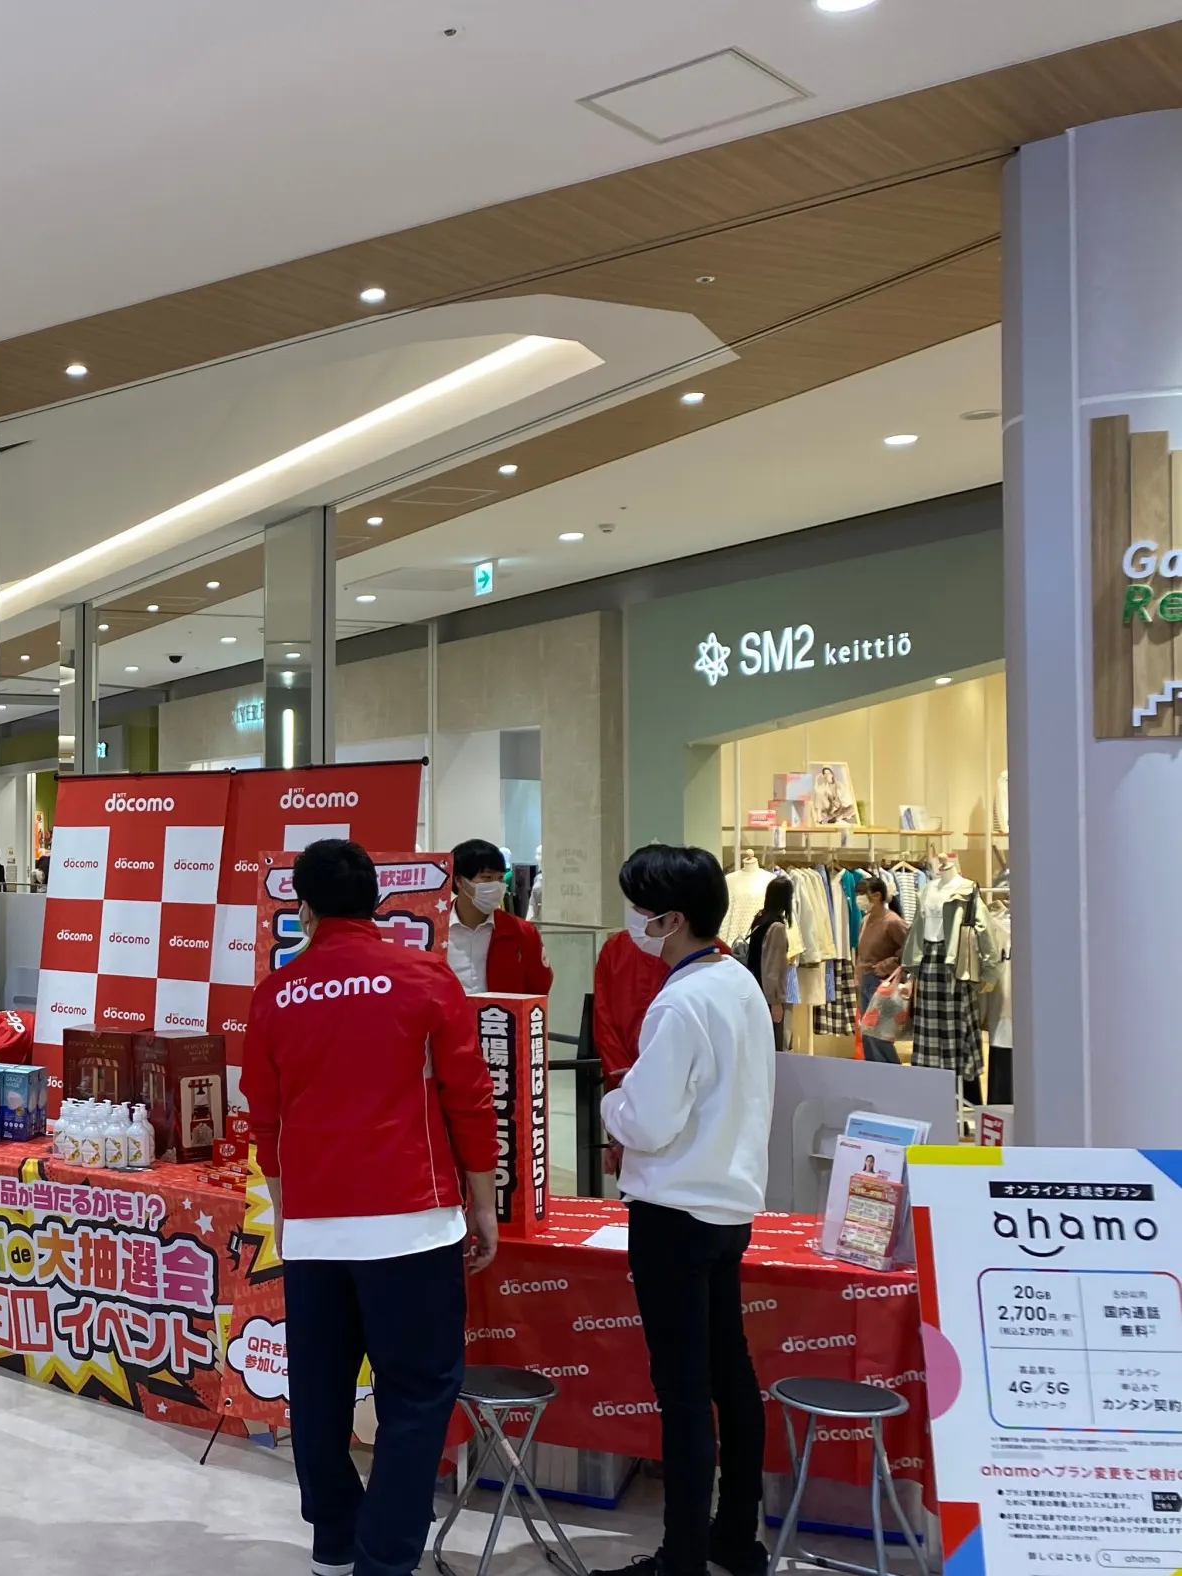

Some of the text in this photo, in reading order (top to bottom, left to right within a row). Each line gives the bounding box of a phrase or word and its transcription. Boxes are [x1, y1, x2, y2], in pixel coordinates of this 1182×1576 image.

[739, 624, 912, 675] SM2 keittiö
[104, 793, 175, 812] docomo
[279, 788, 359, 809] docomo
[63, 858, 99, 868] docomo
[114, 858, 155, 870] docomo
[174, 859, 215, 871] docomo
[234, 860, 259, 872] doco
[56, 929, 94, 942] docomo
[109, 932, 151, 945] docomo
[169, 936, 210, 949] docomo
[228, 939, 255, 951] doco
[275, 975, 392, 1008] NTT docomo
[50, 1002, 88, 1016] docomo
[103, 1007, 146, 1021] docomo
[165, 1012, 205, 1027] docomo
[530, 1007, 545, 1214] 会場はこちら!!
[1003, 1185, 1142, 1198] オンライン手続きプラン
[993, 1208, 1159, 1241] ahamo
[499, 1278, 568, 1296] docomo
[1013, 1286, 1052, 1300] 20GB
[1104, 1305, 1161, 1320] 国内通話
[781, 1334, 857, 1353] docomo
[1102, 1399, 1182, 1412] カンタン契約
[1124, 1555, 1161, 1563] ahamo
